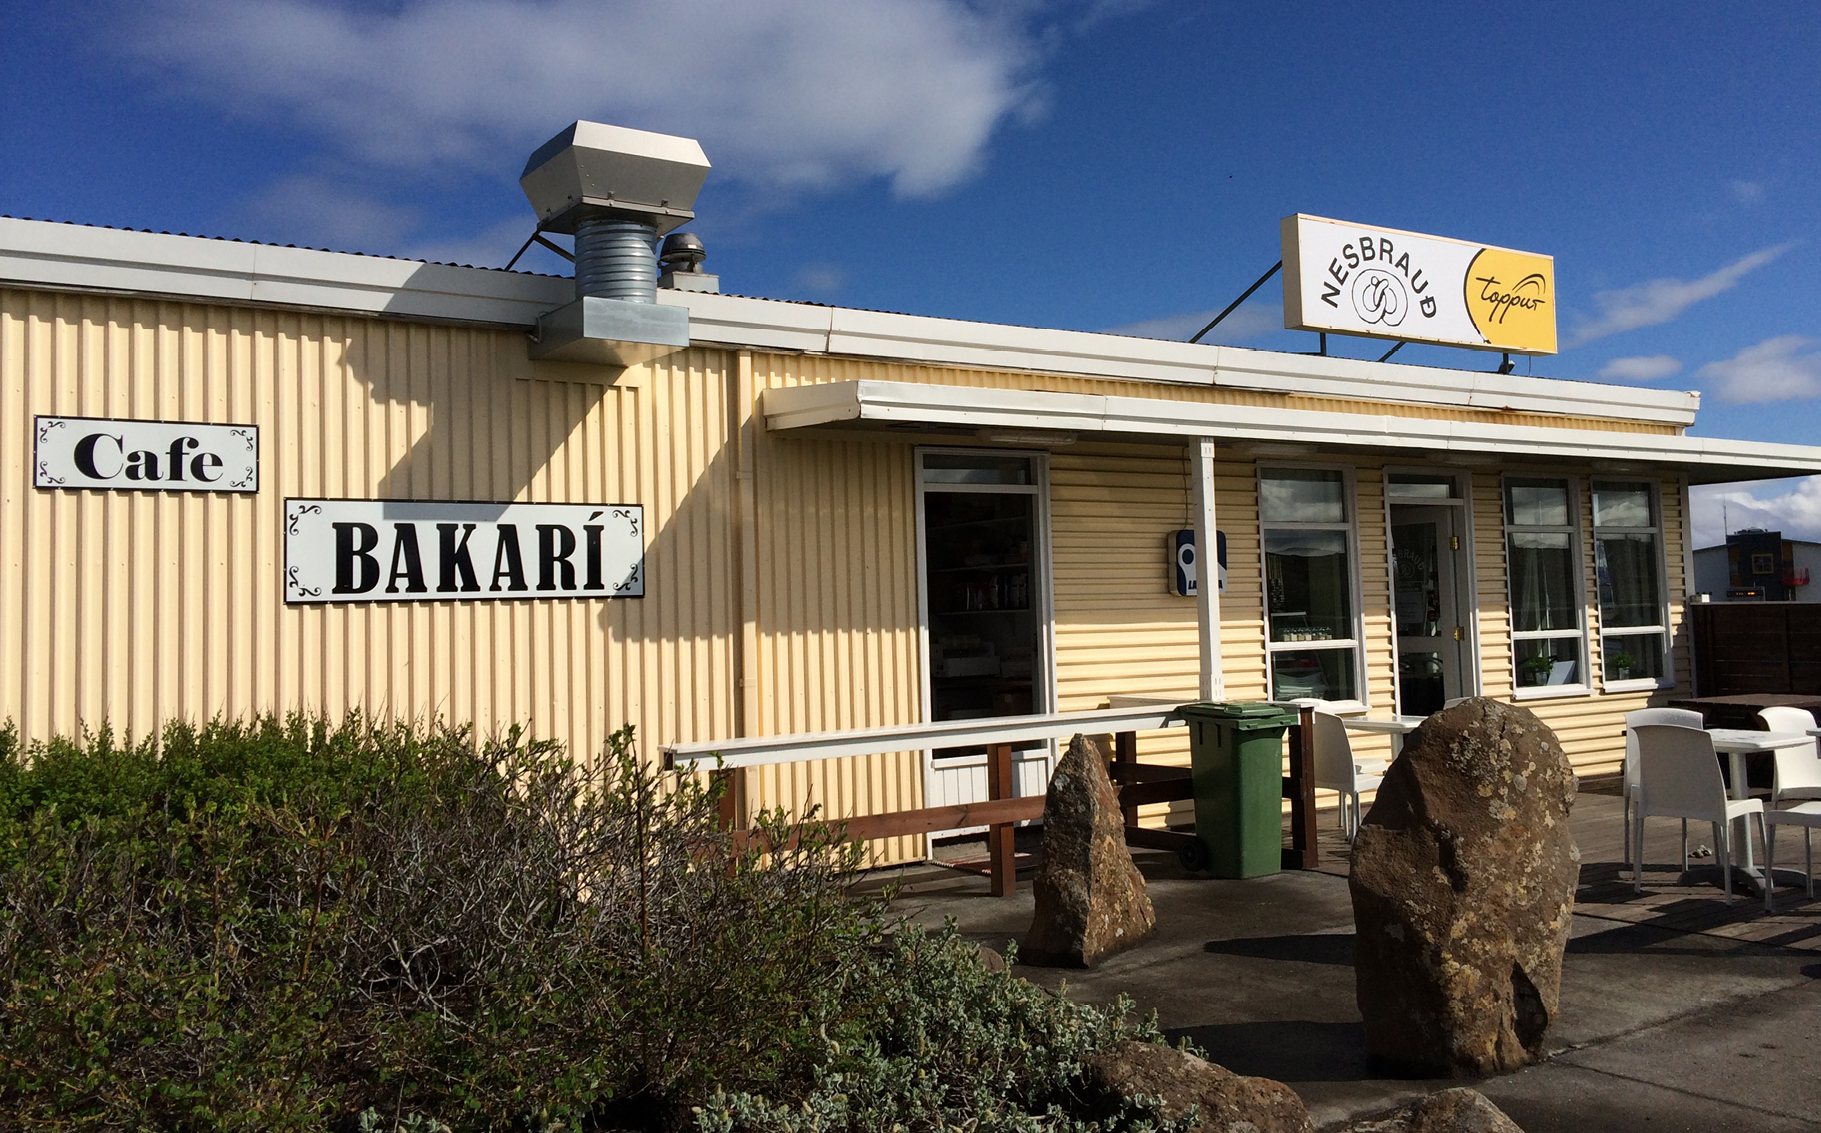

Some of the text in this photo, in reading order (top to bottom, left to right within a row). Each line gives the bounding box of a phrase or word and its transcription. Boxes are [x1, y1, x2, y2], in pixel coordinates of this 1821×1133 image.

[1321, 236, 1437, 319] NESBRAUÐ
[73, 432, 224, 483] Cafe
[331, 510, 606, 595] BAKARÍ
